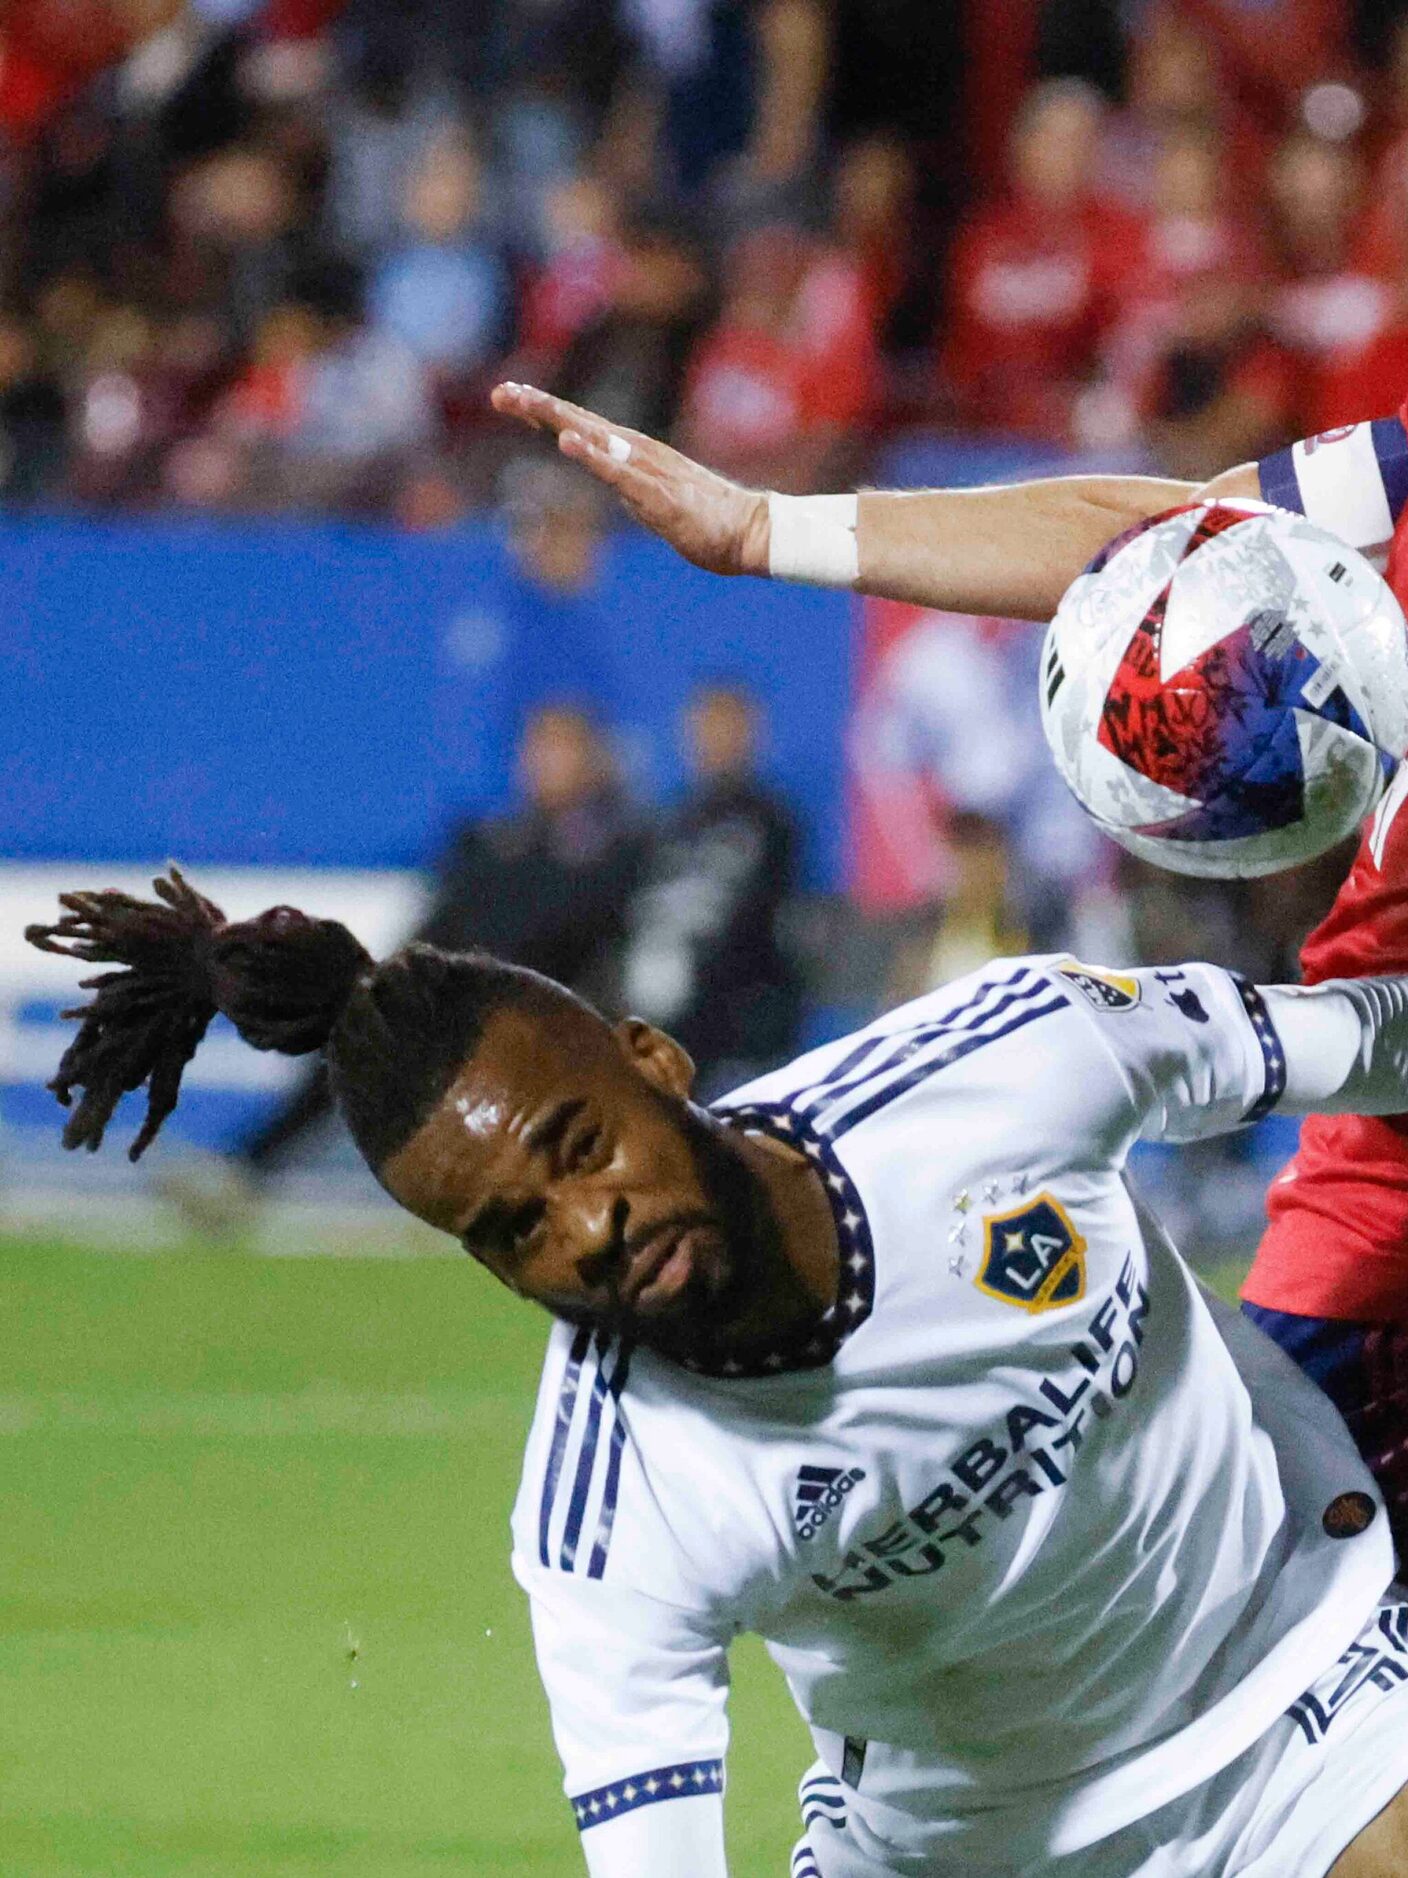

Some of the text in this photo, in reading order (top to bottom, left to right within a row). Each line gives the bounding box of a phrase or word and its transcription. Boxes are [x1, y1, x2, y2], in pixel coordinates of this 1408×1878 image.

[1005, 1233, 1063, 1290] LA
[799, 1467, 866, 1540] adidas
[811, 1250, 1137, 1593] HERBALIFE
[832, 1282, 1150, 1600] NUTRITION
